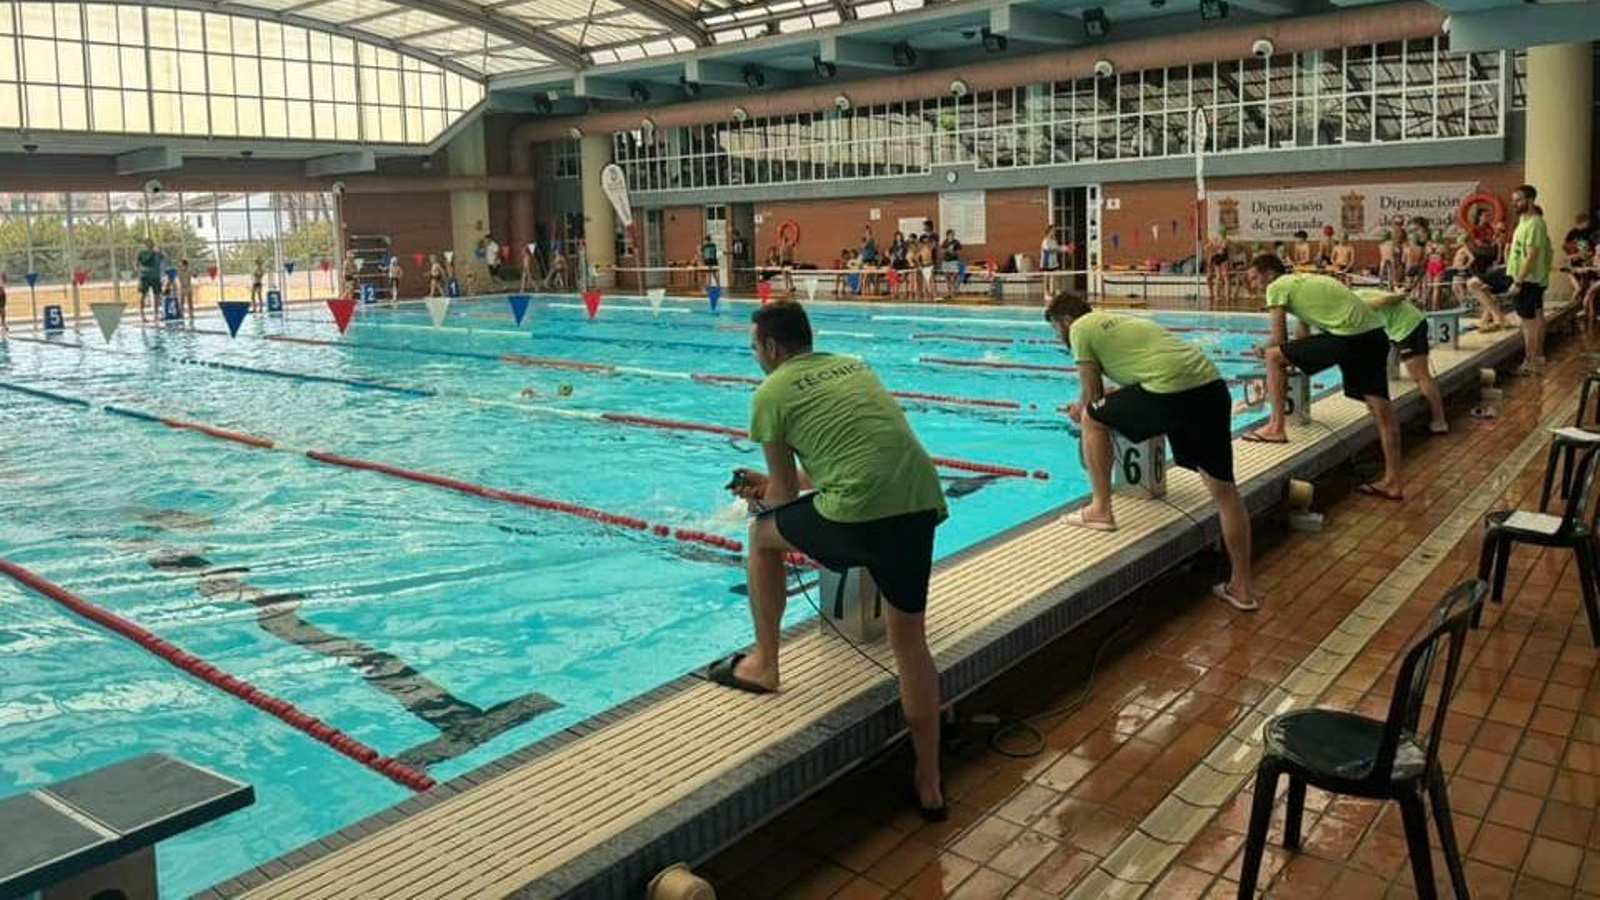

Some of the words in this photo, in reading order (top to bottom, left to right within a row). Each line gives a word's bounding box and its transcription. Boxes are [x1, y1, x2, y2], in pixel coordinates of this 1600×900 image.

[1251, 219, 1265, 230] de
[49, 308, 60, 325] 5
[1439, 323, 1450, 342] 3
[1123, 447, 1142, 485] 6
